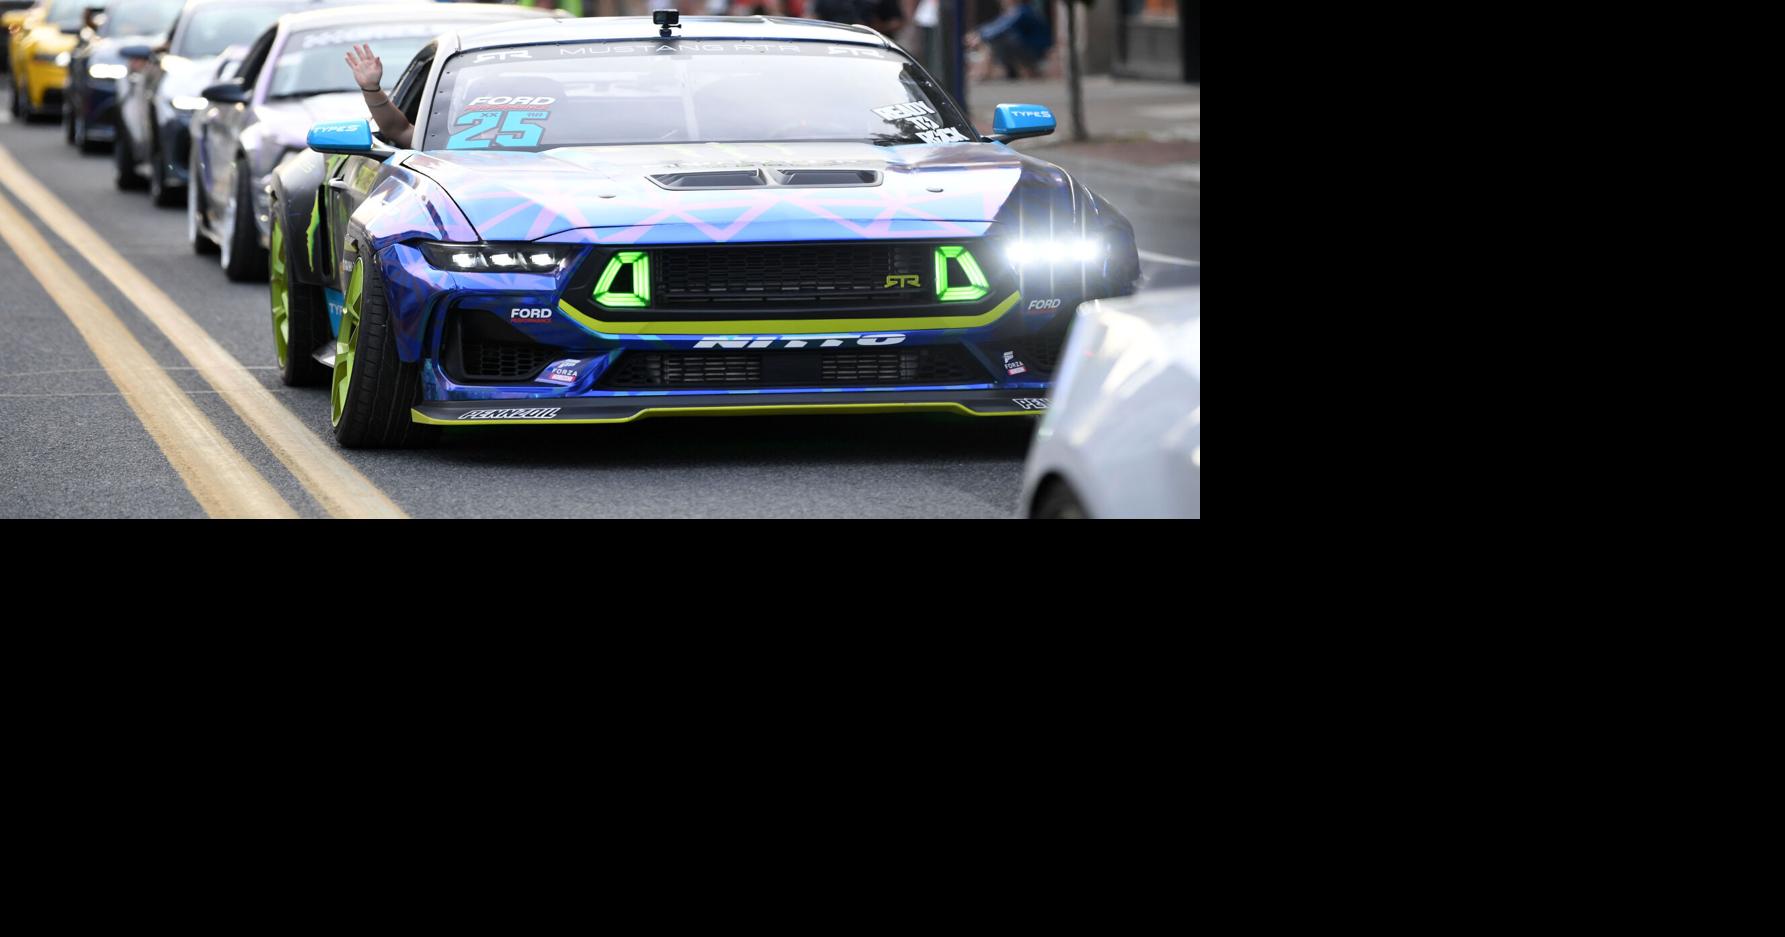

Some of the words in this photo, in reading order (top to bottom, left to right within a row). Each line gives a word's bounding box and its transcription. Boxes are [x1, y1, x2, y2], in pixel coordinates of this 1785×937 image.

[560, 44, 724, 56] MUSTANG
[735, 44, 800, 53] RTR
[468, 96, 556, 106] FORD
[872, 101, 936, 121] READY
[446, 110, 551, 150] 25
[1028, 299, 1061, 310] FORD
[511, 308, 552, 319] FORD
[693, 333, 906, 349] NITTO
[1004, 361, 1024, 370] FORZA
[551, 367, 578, 377] FORZA
[458, 407, 562, 420] PENNZOIL
